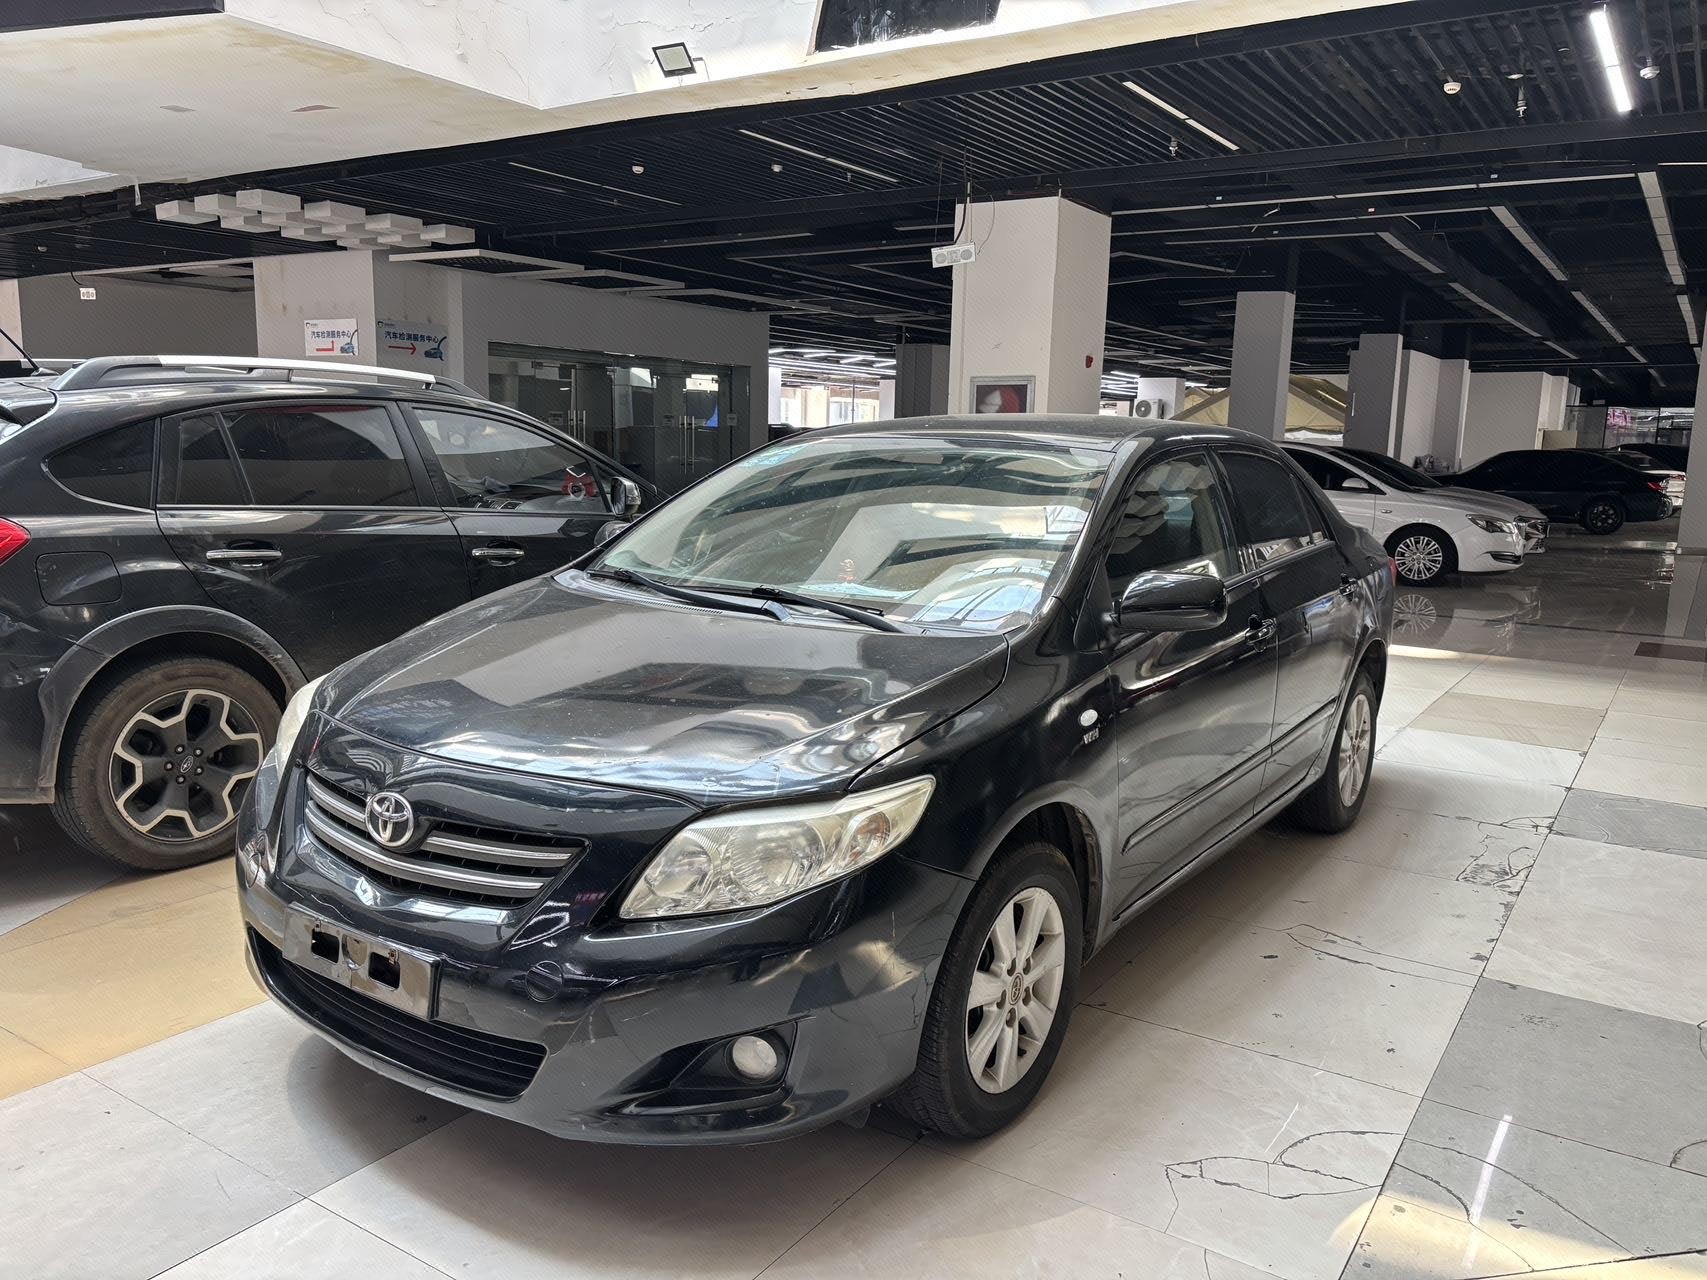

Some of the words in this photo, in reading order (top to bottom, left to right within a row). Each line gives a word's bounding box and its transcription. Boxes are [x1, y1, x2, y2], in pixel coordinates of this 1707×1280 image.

[311, 330, 351, 339] 汽车检测服务中心
[384, 331, 439, 343] 汽车检测服务中心
